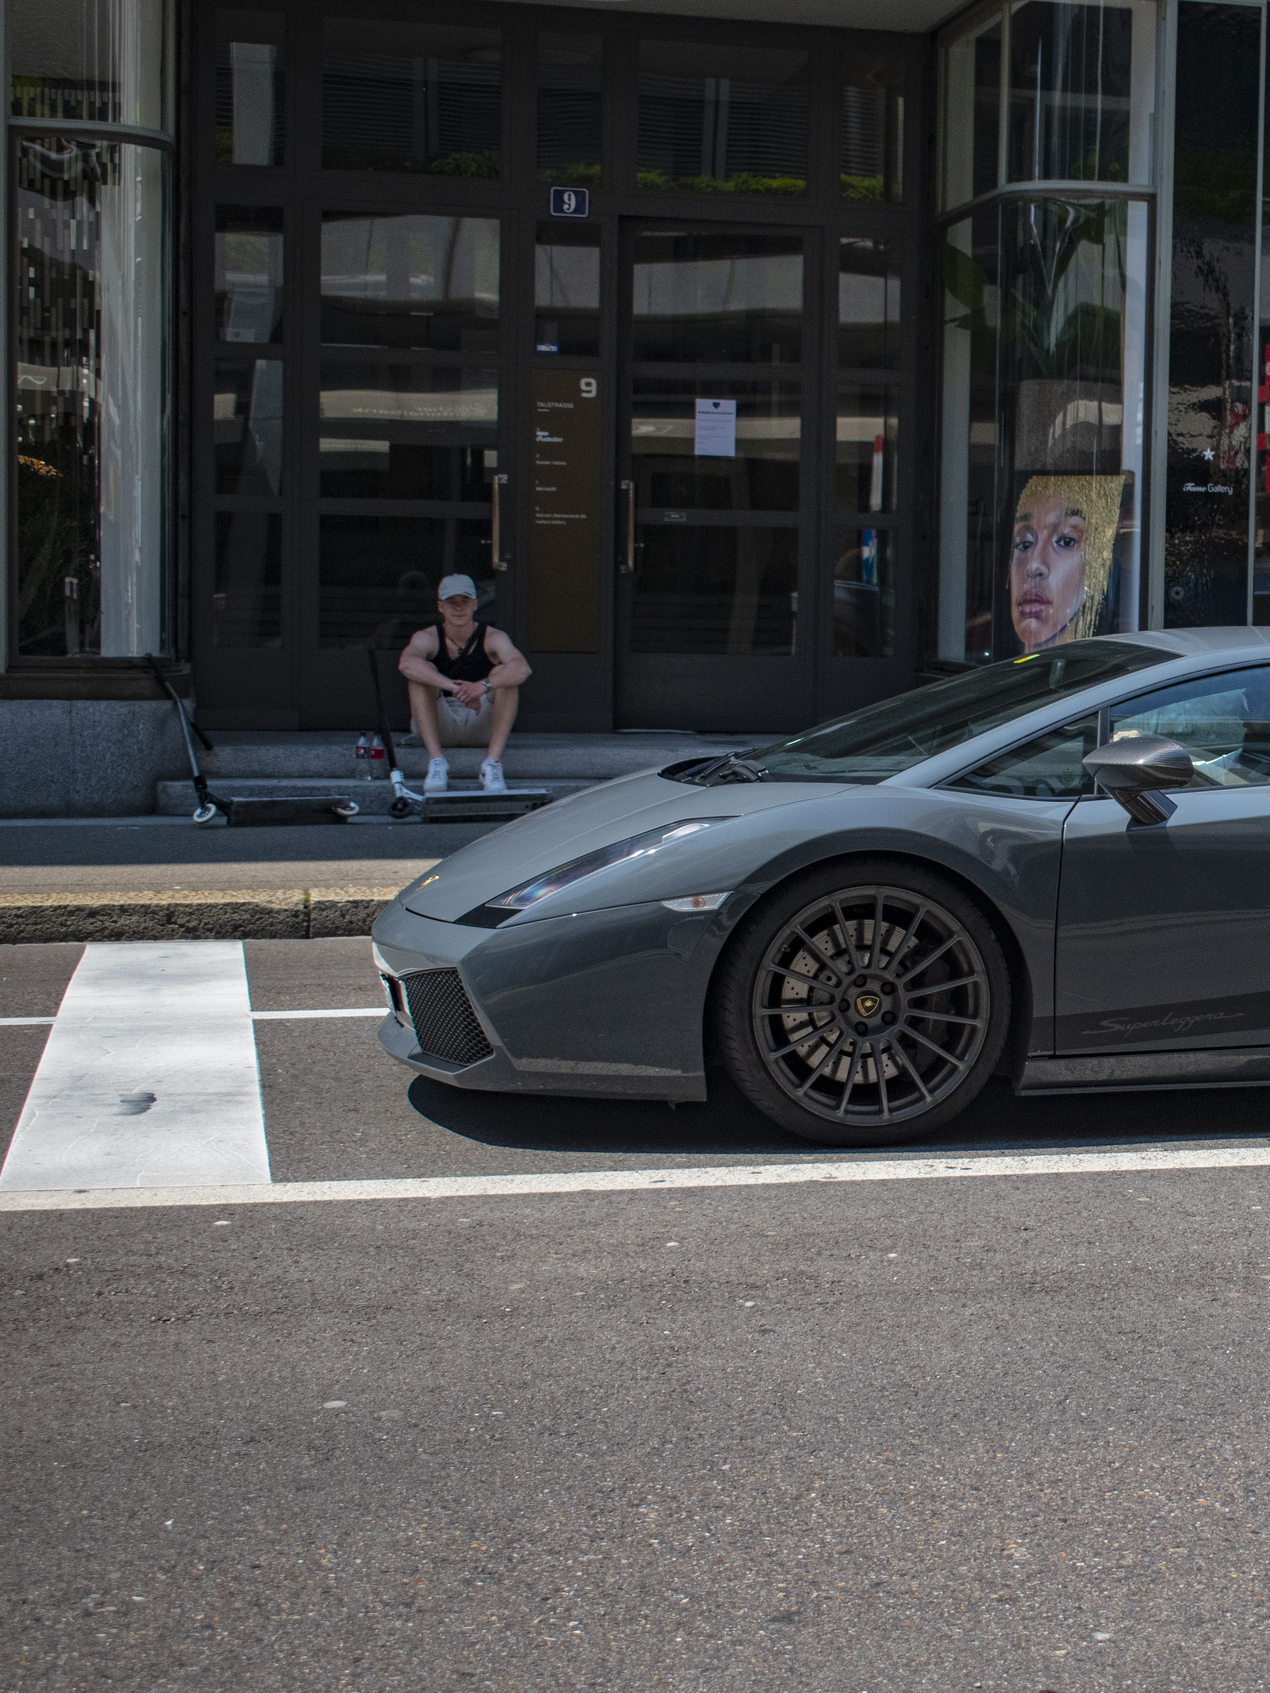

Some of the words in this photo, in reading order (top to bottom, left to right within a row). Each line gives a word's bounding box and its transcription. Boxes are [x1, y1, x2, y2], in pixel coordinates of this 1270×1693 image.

[563, 191, 577, 213] 9
[579, 378, 598, 398] 9
[1182, 482, 1207, 493] Fame
[1208, 483, 1234, 496] Gallery
[1082, 1011, 1244, 1038] Superleggera
